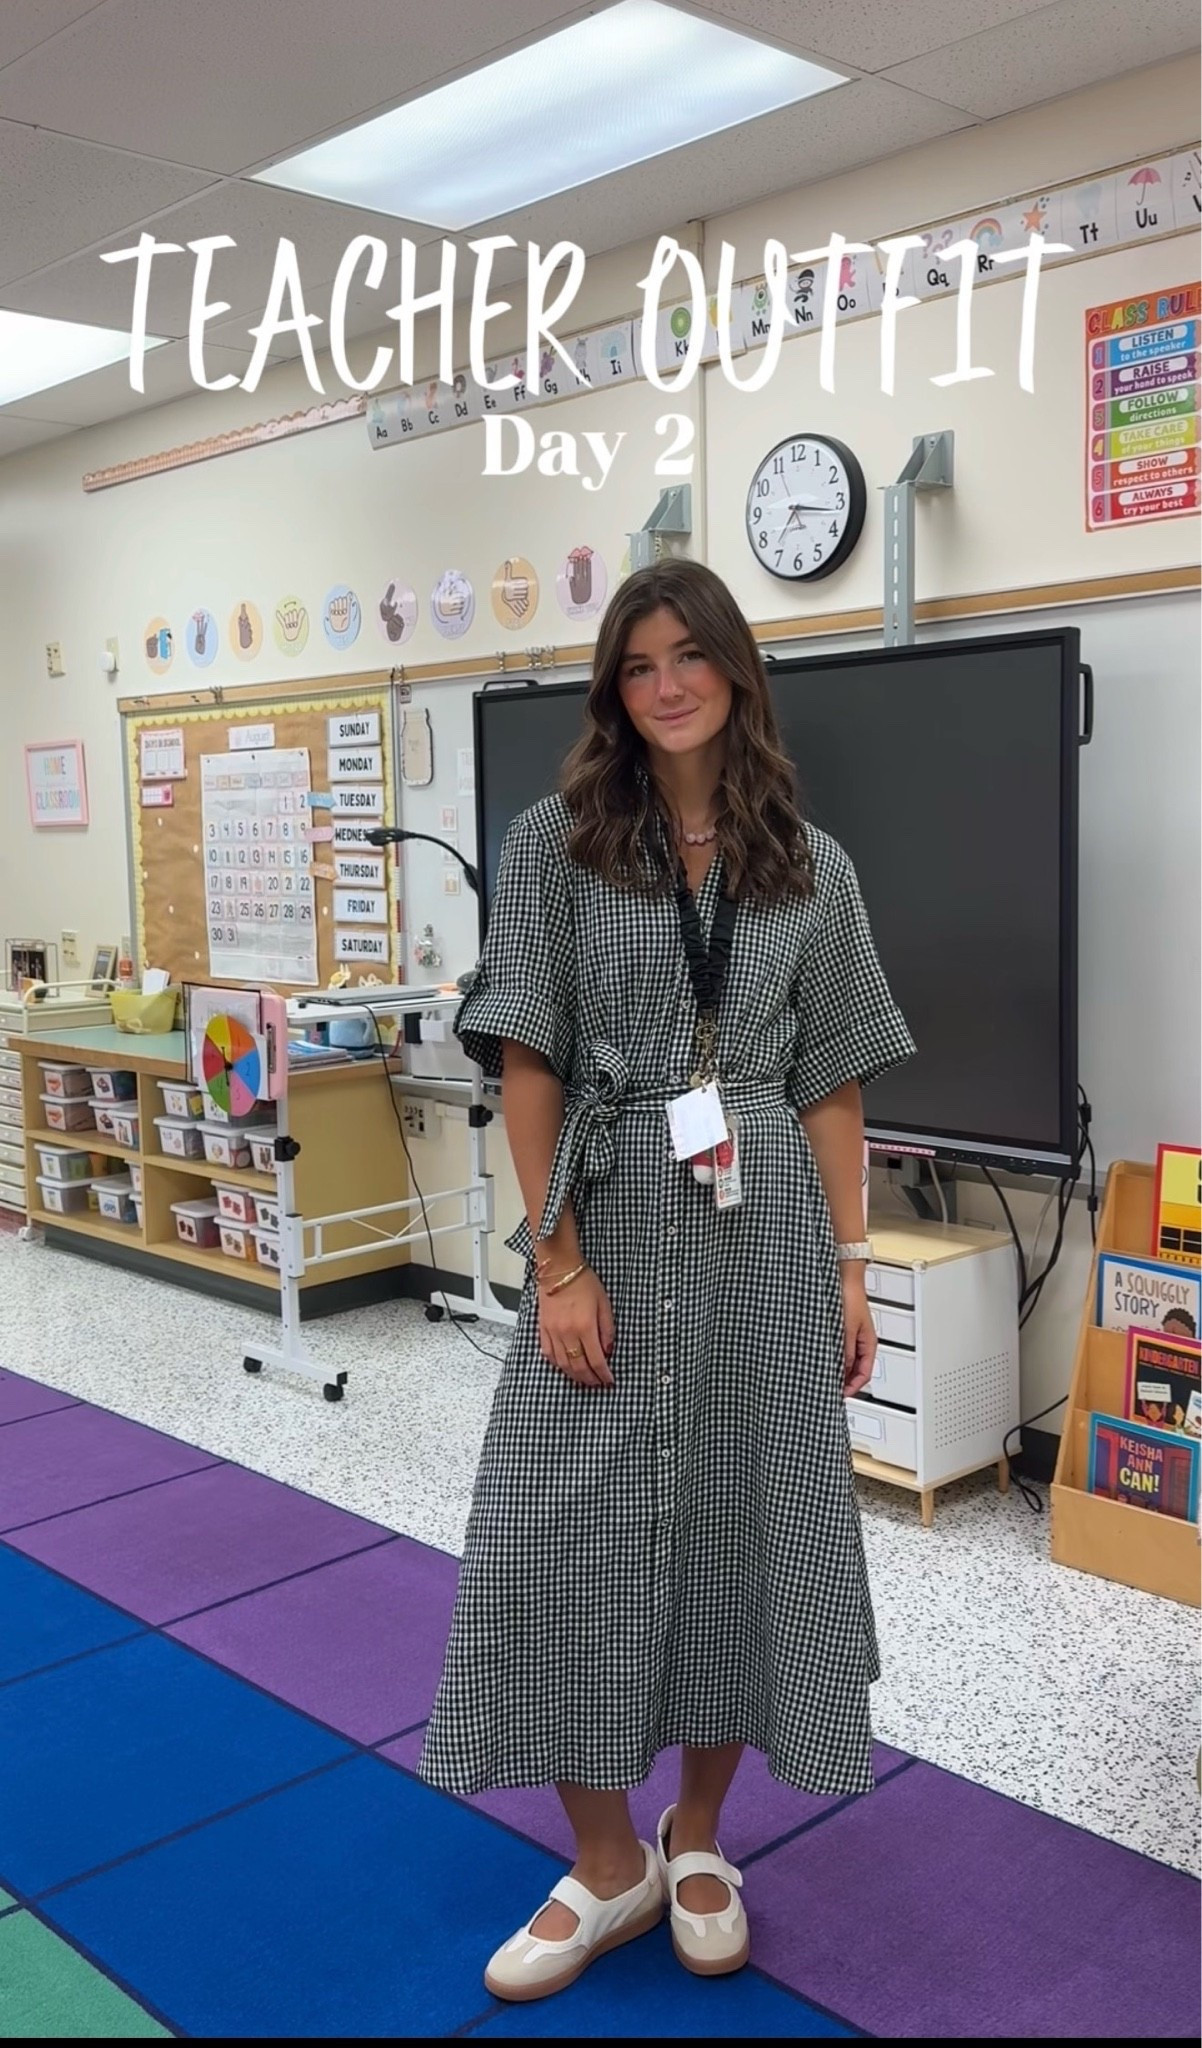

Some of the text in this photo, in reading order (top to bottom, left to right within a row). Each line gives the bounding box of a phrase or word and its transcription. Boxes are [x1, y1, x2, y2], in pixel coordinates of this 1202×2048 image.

[375, 426, 388, 440] Aa
[401, 418, 413, 433] Bb
[428, 411, 440, 425] Cc
[454, 403, 468, 418] Dd
[484, 395, 496, 410] Ee
[514, 385, 526, 401] Ff
[544, 378, 558, 395] Gg
[610, 360, 622, 375] Ii
[795, 305, 813, 324] Nn
[837, 294, 856, 311] Oo
[926, 268, 950, 288] Qq
[978, 254, 995, 274] Rr
[1080, 222, 1099, 245] Tt
[1136, 208, 1158, 229] Uu
[1088, 299, 1149, 334] CLASS
[1131, 328, 1175, 348] LISTEN
[1120, 341, 1187, 362] to the speaker
[1132, 361, 1170, 379] RAISE
[1095, 378, 1104, 395] 2
[1114, 370, 1194, 396] your hand to speak
[1127, 391, 1179, 410] FOLLOW
[1129, 406, 1177, 422] directions
[1123, 421, 1185, 442] TAKE CARE
[790, 443, 807, 463] 12
[814, 448, 821, 467] 1
[773, 456, 785, 475] 11
[1136, 456, 1169, 470] SHOW
[828, 465, 839, 484] 2
[1095, 471, 1103, 487] 5
[1113, 466, 1193, 488] respect to others
[756, 478, 770, 497] 10
[1132, 486, 1174, 502] ALWAYS
[835, 492, 845, 511] 3
[1094, 501, 1103, 517] 6
[1122, 498, 1184, 517] try your best
[752, 506, 762, 525] 9
[828, 519, 839, 538] 4
[758, 531, 768, 549] 8
[774, 549, 784, 568] 7
[793, 552, 803, 571] 6
[813, 543, 822, 562] 5
[339, 721, 370, 738] SUNDAY
[339, 757, 373, 772] MONDAY
[300, 794, 306, 808] 2
[339, 793, 376, 807] TUESDAY
[209, 824, 216, 838] 3
[223, 823, 230, 837] 4
[238, 822, 244, 836] 5
[252, 822, 258, 837] 6
[267, 822, 273, 836] 7
[283, 823, 289, 837] 8
[335, 828, 367, 842] WEDNES
[209, 849, 217, 862] 10
[238, 850, 245, 864] 12
[252, 849, 260, 863] 13
[284, 850, 291, 864] 15
[300, 849, 308, 864] 16
[340, 863, 379, 878] THURSDAY
[210, 875, 218, 889] 17
[268, 876, 278, 890] 20
[285, 876, 292, 890] 21
[300, 877, 310, 891] 22
[211, 901, 311, 920] 23 25 26 27 28 29
[347, 899, 376, 913] FRIDAY
[211, 927, 234, 941] 30 31
[342, 939, 383, 953] SATURDAY
[1114, 1271, 1191, 1305] A SQUIGGLY
[1114, 1291, 1160, 1318] STORY
[1139, 1346, 1199, 1375] KINDERGARTEN
[1119, 1436, 1164, 1463] KEISHA
[1127, 1456, 1154, 1474] ANN
[1119, 1467, 1160, 1494] CAN!
